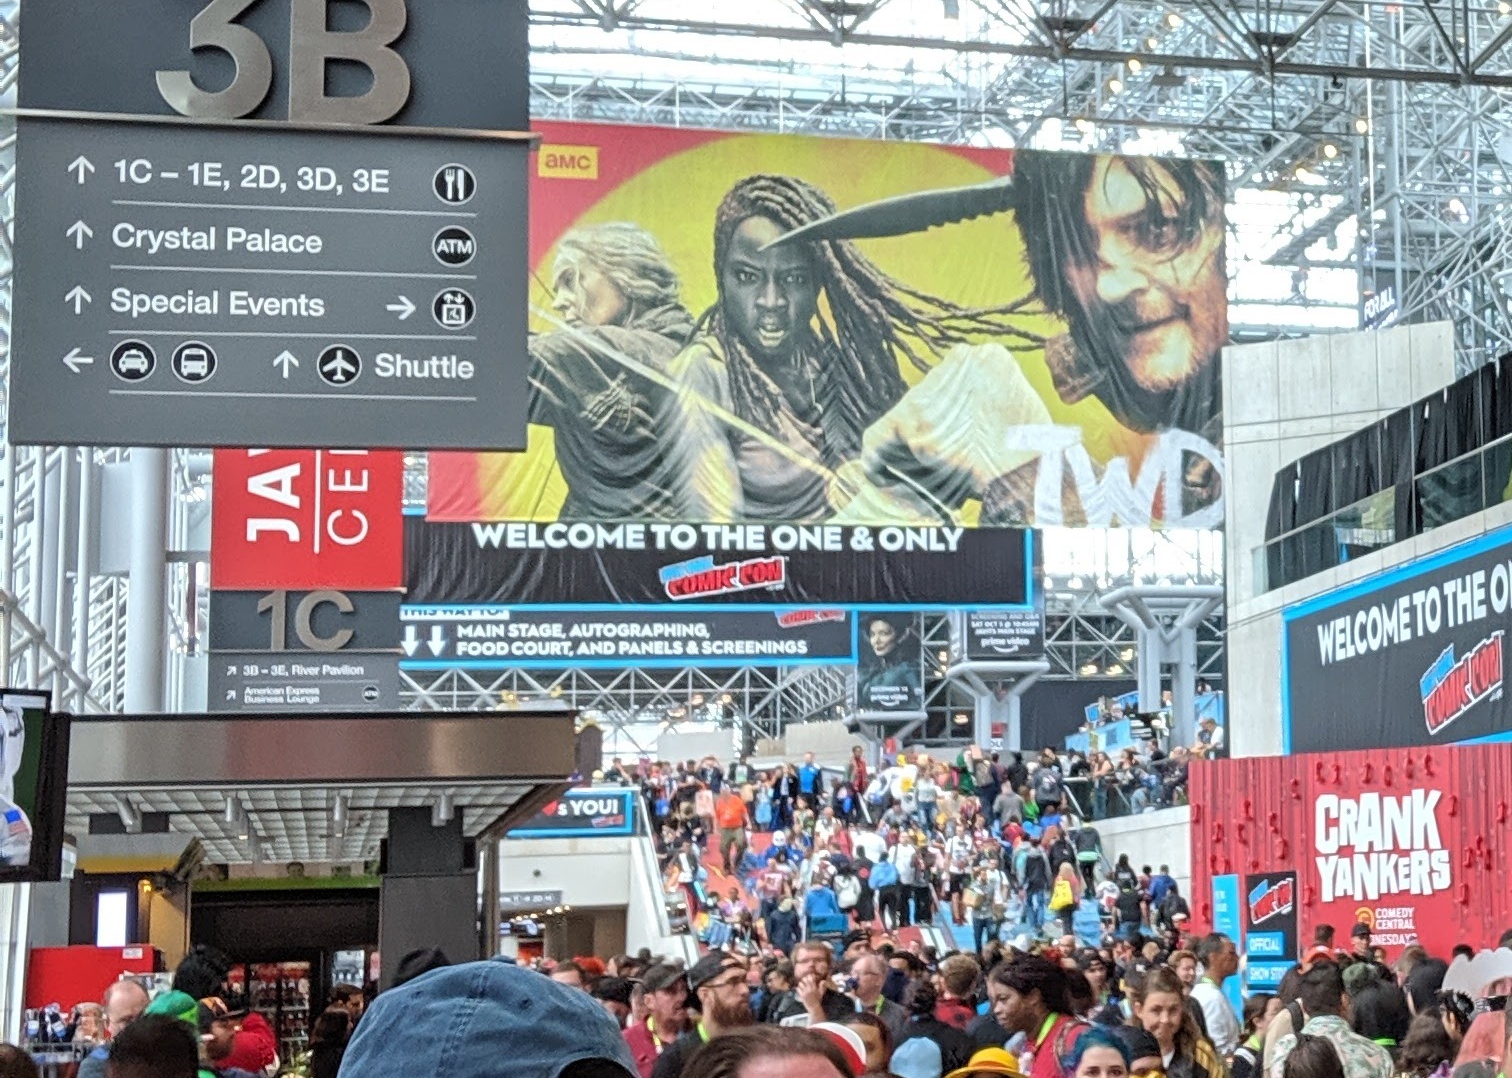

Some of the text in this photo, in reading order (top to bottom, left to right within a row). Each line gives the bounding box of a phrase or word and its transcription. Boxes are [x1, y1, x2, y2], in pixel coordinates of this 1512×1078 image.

[114, 159, 152, 184] 1C
[187, 163, 230, 191] 1E,
[240, 164, 287, 193] 2D,
[297, 167, 343, 195] 3D,
[352, 169, 390, 193] 3E
[112, 223, 323, 258] Crystal Palace
[437, 240, 472, 254] ATM
[110, 288, 325, 319] Special Events
[375, 354, 475, 380] Shuttle
[1007, 423, 1225, 528] TWD
[471, 523, 964, 552] WELCOME TO THE ONE & ONLY
[666, 558, 783, 597] COMIC CON
[257, 590, 354, 651] 1C
[457, 623, 710, 639] MAIN STAGE, AUTOGRAPHING,
[1317, 596, 1411, 666] WELCOME
[1411, 585, 1441, 638] TO
[1443, 569, 1487, 629] THE
[456, 640, 808, 657] FOOD COURT, AND PANELS & SCREENINGS
[980, 636, 1031, 648] prime video
[292, 665, 320, 676] River
[322, 664, 365, 676] Pavilion
[1426, 634, 1500, 728] COMIC CON
[569, 799, 619, 816] YOU!
[1315, 788, 1443, 855] CRANK
[1315, 849, 1453, 903] YANKERS
[1375, 907, 1415, 919] COMEDY
[1375, 918, 1416, 930] CENTRAL
